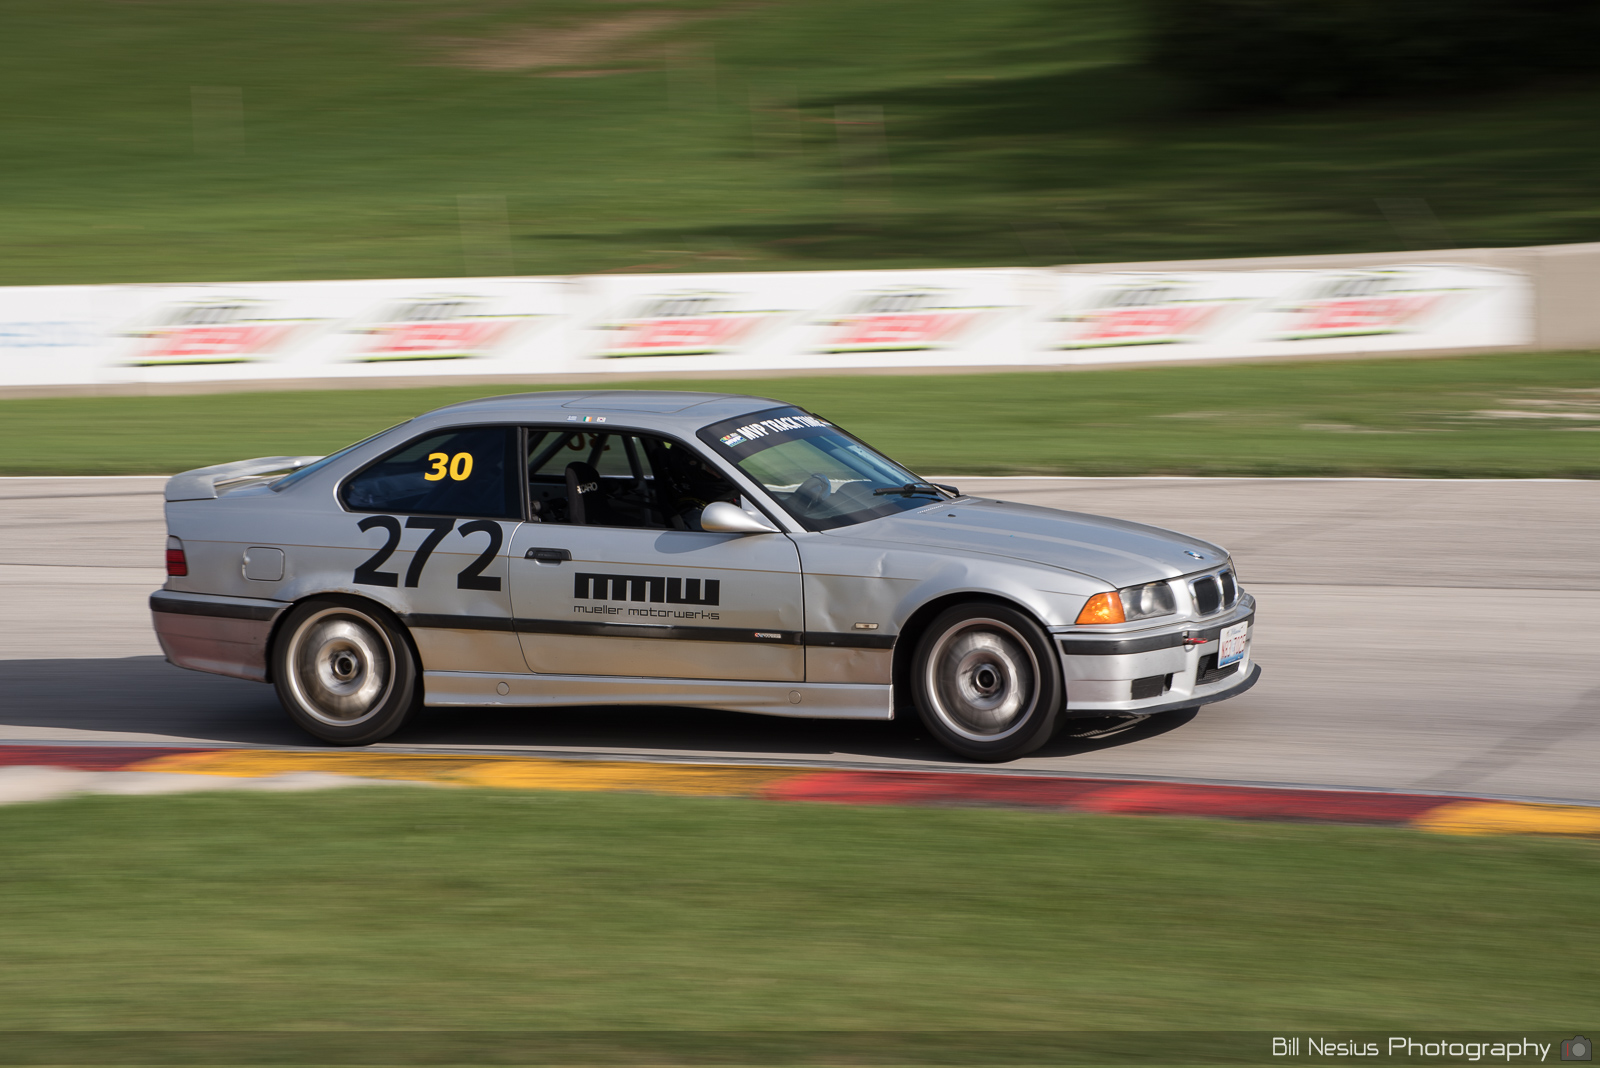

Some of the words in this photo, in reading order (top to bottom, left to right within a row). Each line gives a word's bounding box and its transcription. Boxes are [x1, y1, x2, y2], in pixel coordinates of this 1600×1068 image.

[736, 424, 766, 440] MVP
[760, 417, 804, 433] TRACK
[424, 452, 473, 481] 30
[353, 515, 503, 591] 272
[574, 605, 623, 615] mueller
[628, 607, 720, 620] motorwerks
